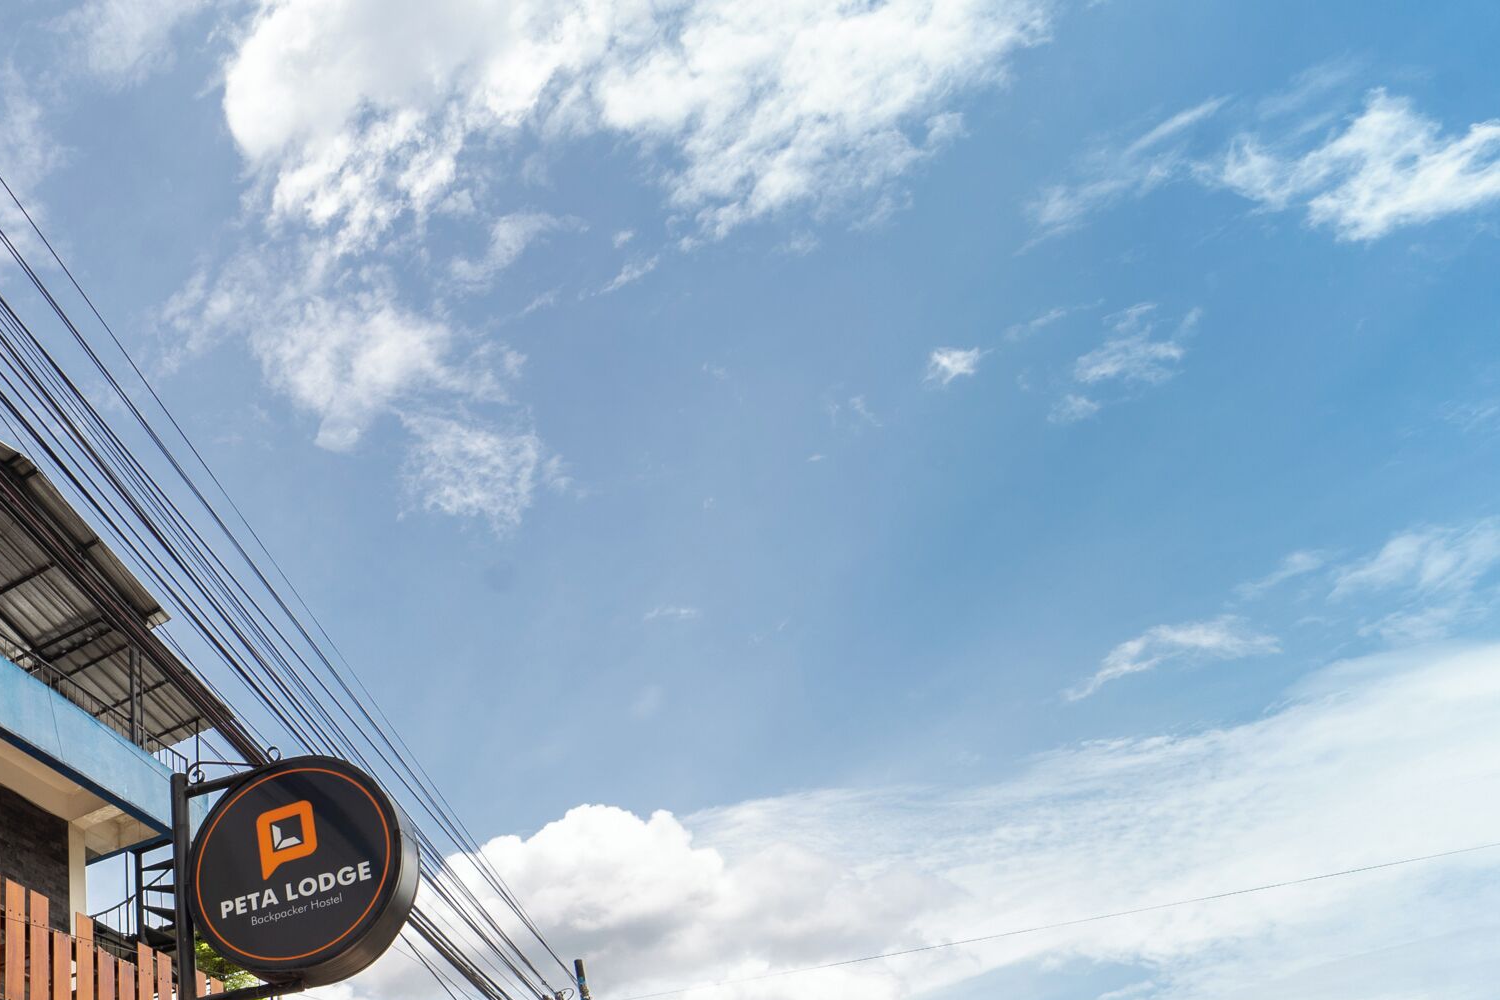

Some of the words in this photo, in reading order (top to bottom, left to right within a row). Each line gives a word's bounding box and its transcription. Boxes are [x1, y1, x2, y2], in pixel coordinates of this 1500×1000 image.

[220, 888, 279, 919] PETA
[285, 861, 372, 901] LODGE
[251, 904, 308, 926] Backpacker
[310, 892, 343, 910] Hostel
